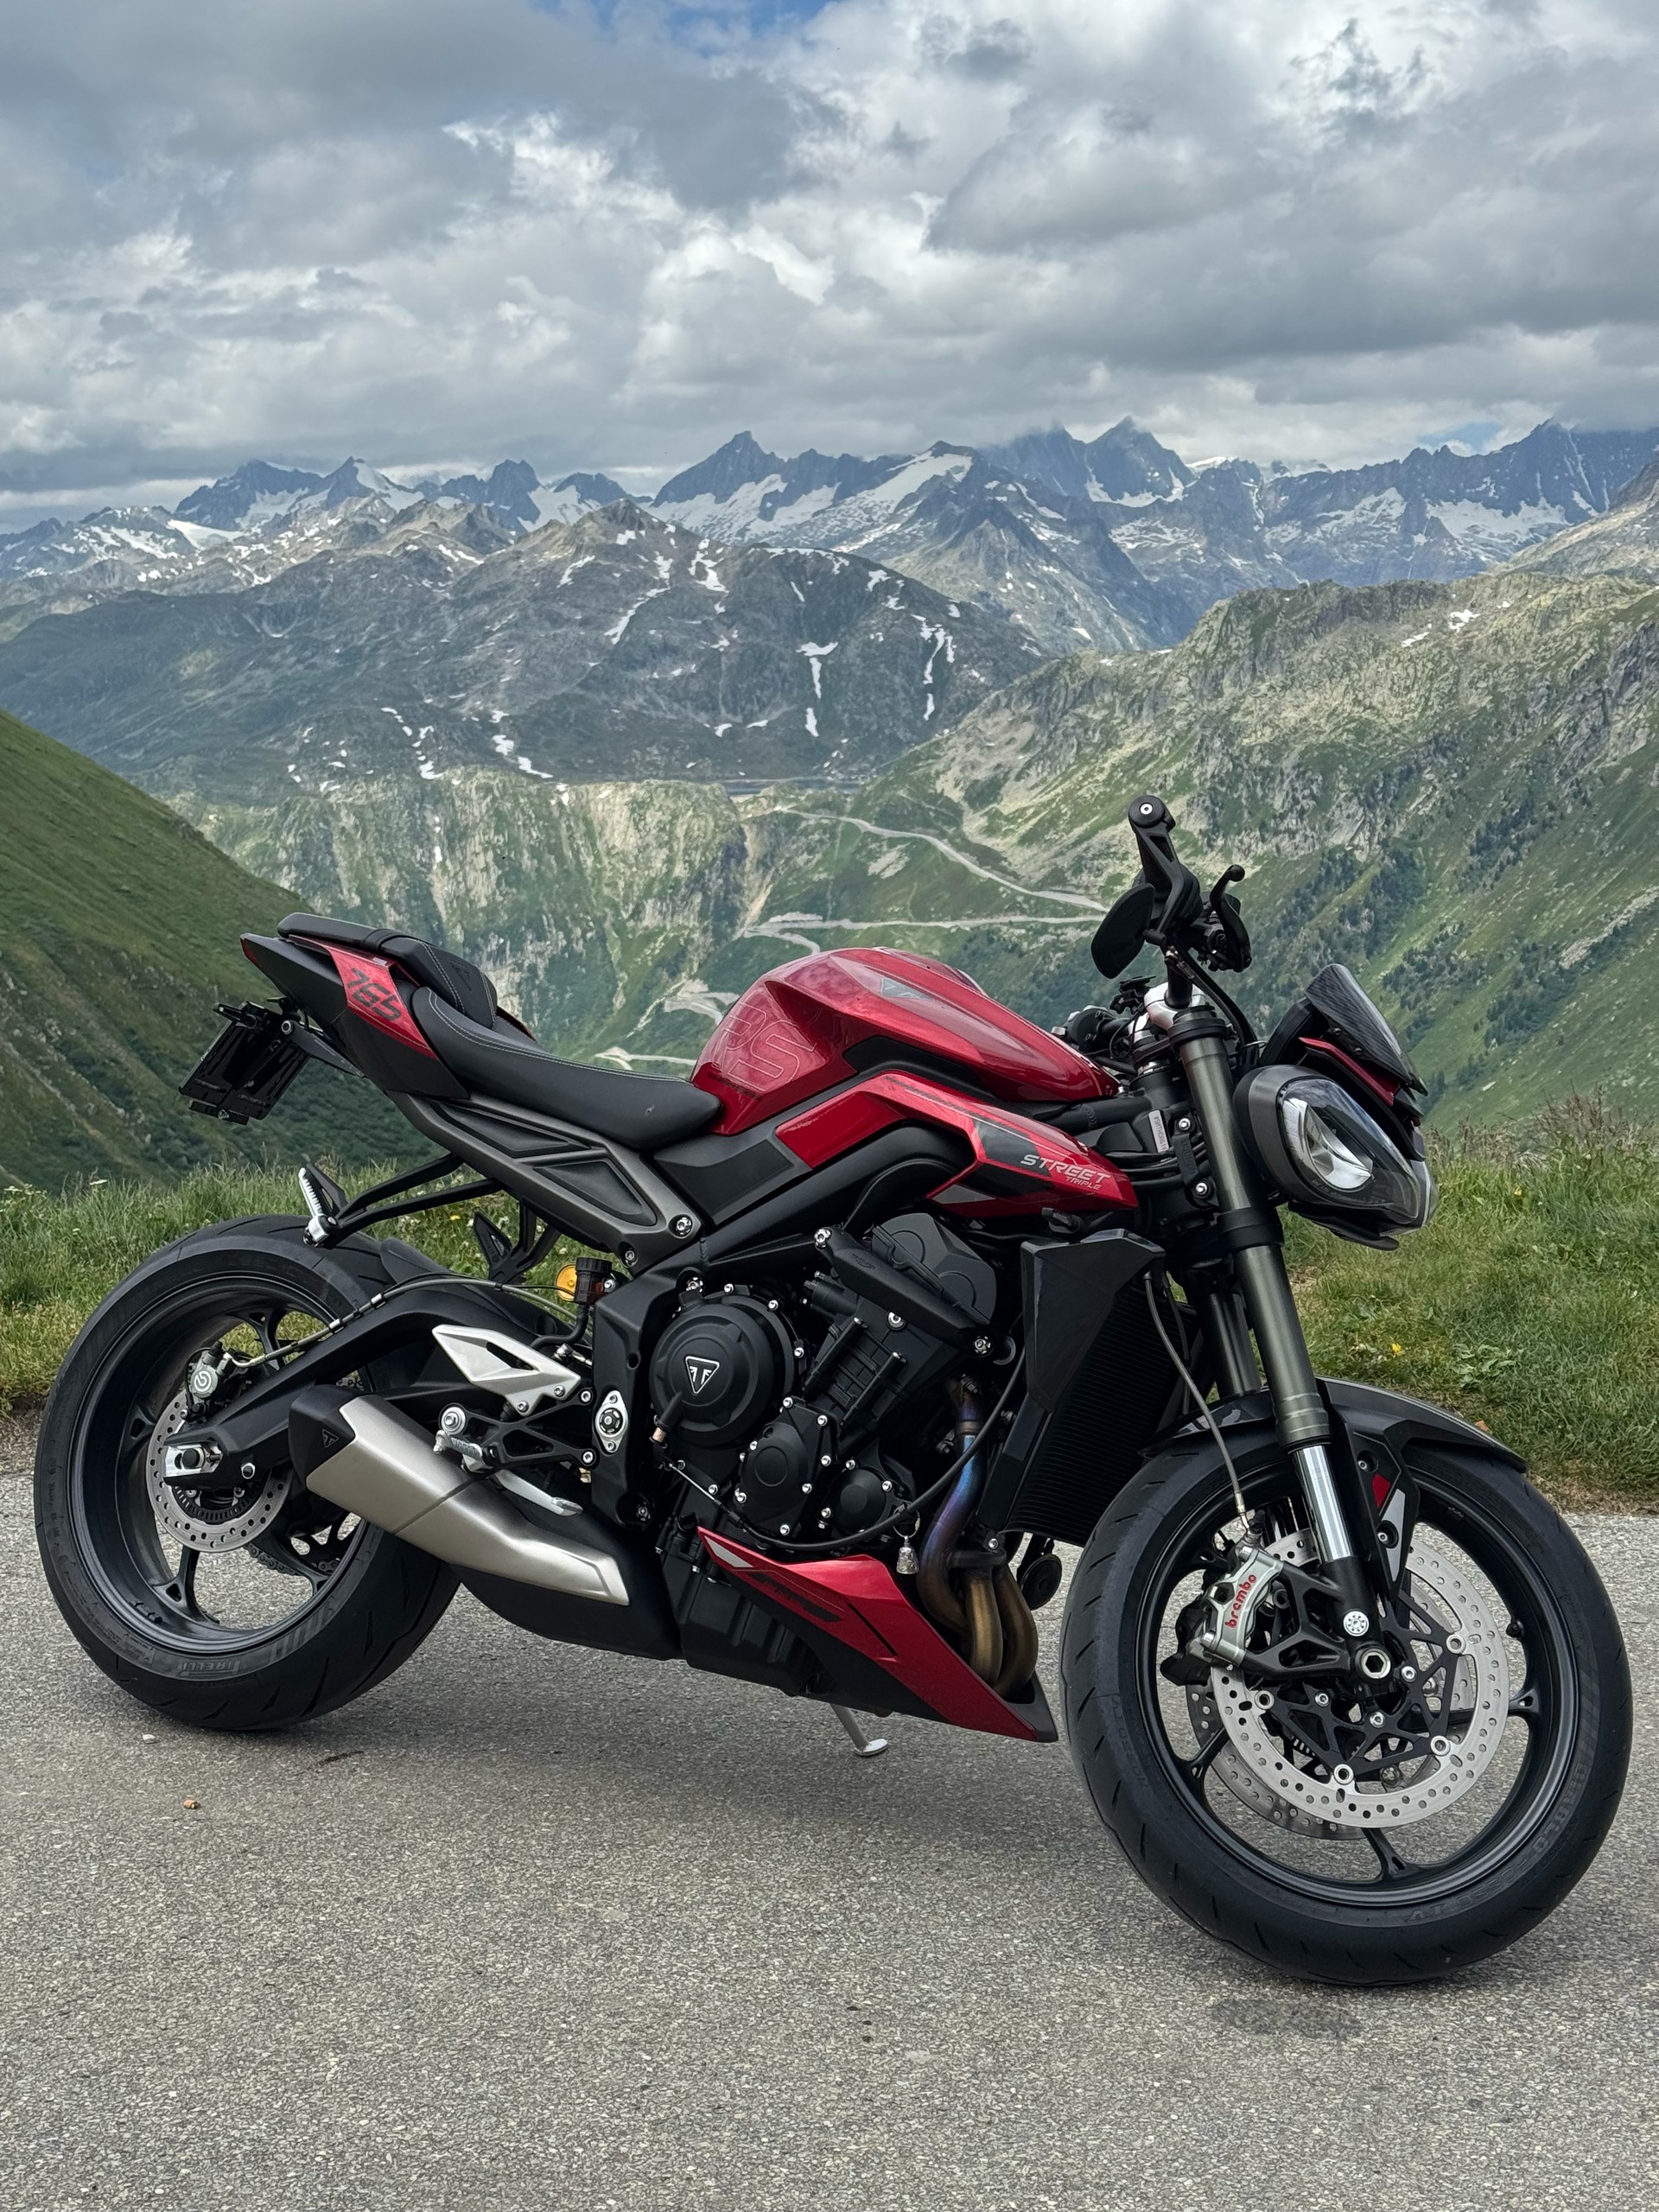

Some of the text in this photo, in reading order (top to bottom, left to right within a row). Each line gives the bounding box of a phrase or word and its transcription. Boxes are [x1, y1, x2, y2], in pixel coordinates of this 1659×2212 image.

[347, 968, 402, 1021] 765
[711, 1001, 817, 1092] RS
[1020, 1154, 1111, 1184] STREET
[1066, 1176, 1102, 1190] TRIPLE
[1224, 1574, 1257, 1629] brembo
